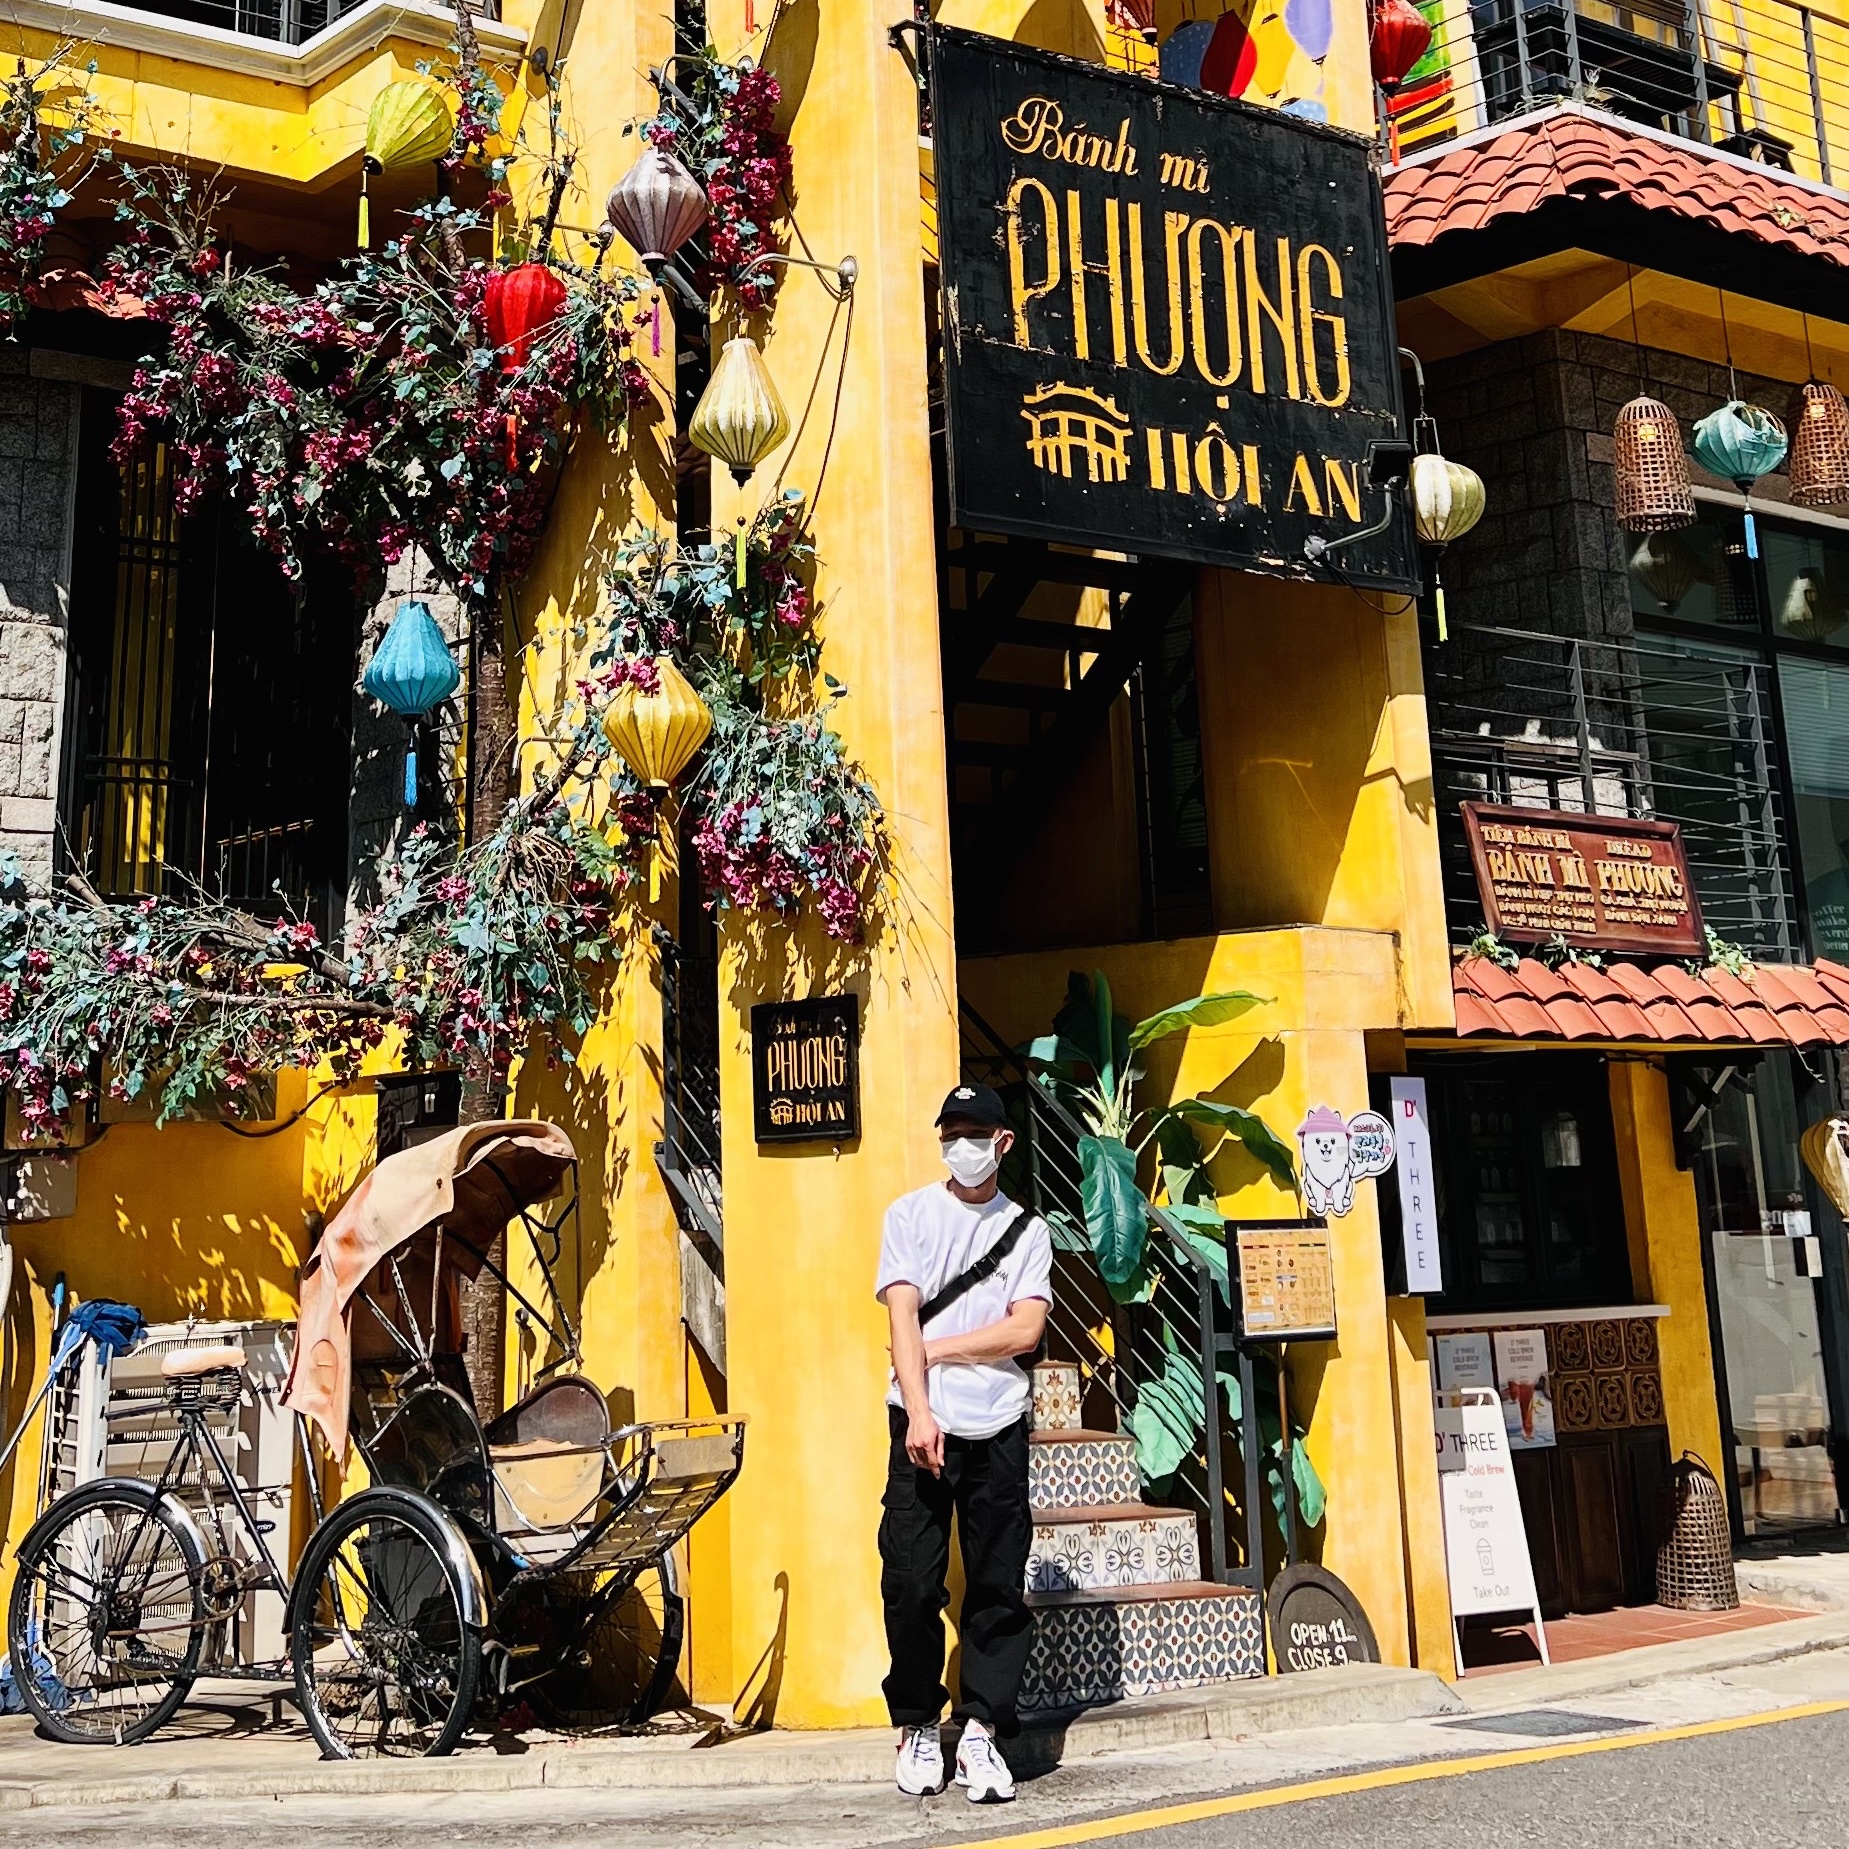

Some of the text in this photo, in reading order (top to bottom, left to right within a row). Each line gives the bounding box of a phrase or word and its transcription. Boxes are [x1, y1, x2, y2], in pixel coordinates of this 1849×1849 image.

[1000, 97, 1139, 176] Bánh
[1146, 420, 1362, 523] HỘI AN
[1485, 844, 1555, 885] BÁNH
[1556, 850, 1591, 888] MÌ
[825, 1100, 846, 1121] AN
[1450, 1432, 1498, 1453] THREE
[1467, 1465, 1485, 1476] Cold
[1486, 1463, 1505, 1475] Brew
[1459, 1504, 1494, 1516] Fragrance
[1473, 1584, 1510, 1598] Take Out
